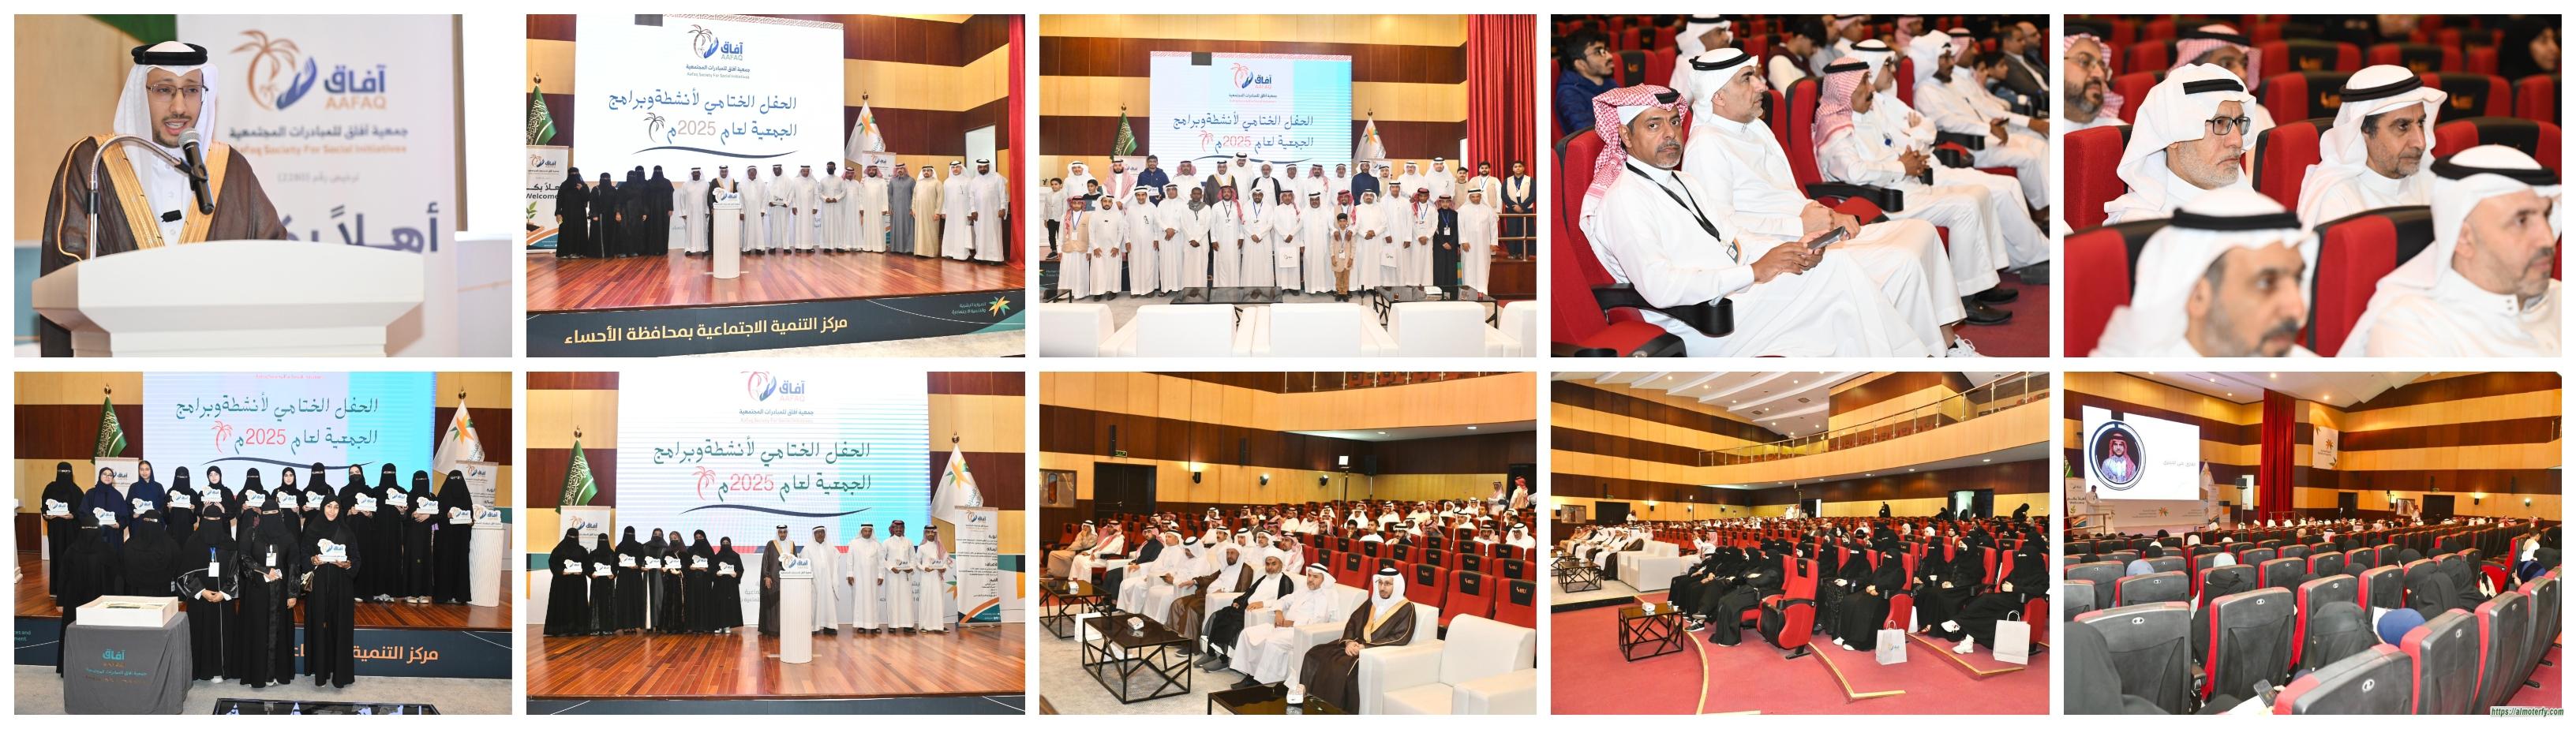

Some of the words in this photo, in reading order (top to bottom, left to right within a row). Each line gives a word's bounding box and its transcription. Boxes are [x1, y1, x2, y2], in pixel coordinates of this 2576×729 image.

[721, 41, 743, 54] آفاق
[324, 65, 387, 94] آفاق
[1255, 74, 1271, 84] آفاق
[324, 96, 388, 110] AAFAQ
[704, 94, 754, 115] الختامي
[760, 95, 796, 114] الحفل
[751, 121, 797, 140] الجمعية
[1242, 114, 1281, 131] الختامي
[1284, 114, 1313, 129] الحفل
[372, 125, 408, 139] جمعية
[721, 122, 747, 145] لعام
[1254, 136, 1275, 155] لعام
[1278, 135, 1313, 150] الجمعية
[626, 326, 694, 342] بمحافظة
[697, 320, 767, 340] الاجتماعية
[770, 317, 818, 335] التنمية
[821, 316, 848, 334] مركز
[564, 325, 622, 345] الأحساء
[779, 380, 806, 394] آفاق
[274, 398, 330, 421] الختامي
[335, 398, 378, 420] الحفل
[291, 429, 320, 455] لعام
[325, 428, 377, 449] الجمعية
[761, 441, 819, 467] الختامي
[826, 441, 870, 464] الحفل
[779, 474, 810, 503] لعام
[816, 472, 871, 495] الجمعية
[102, 649, 125, 660] آفاق
[354, 645, 403, 662] التنمية
[406, 645, 439, 664] مركز
